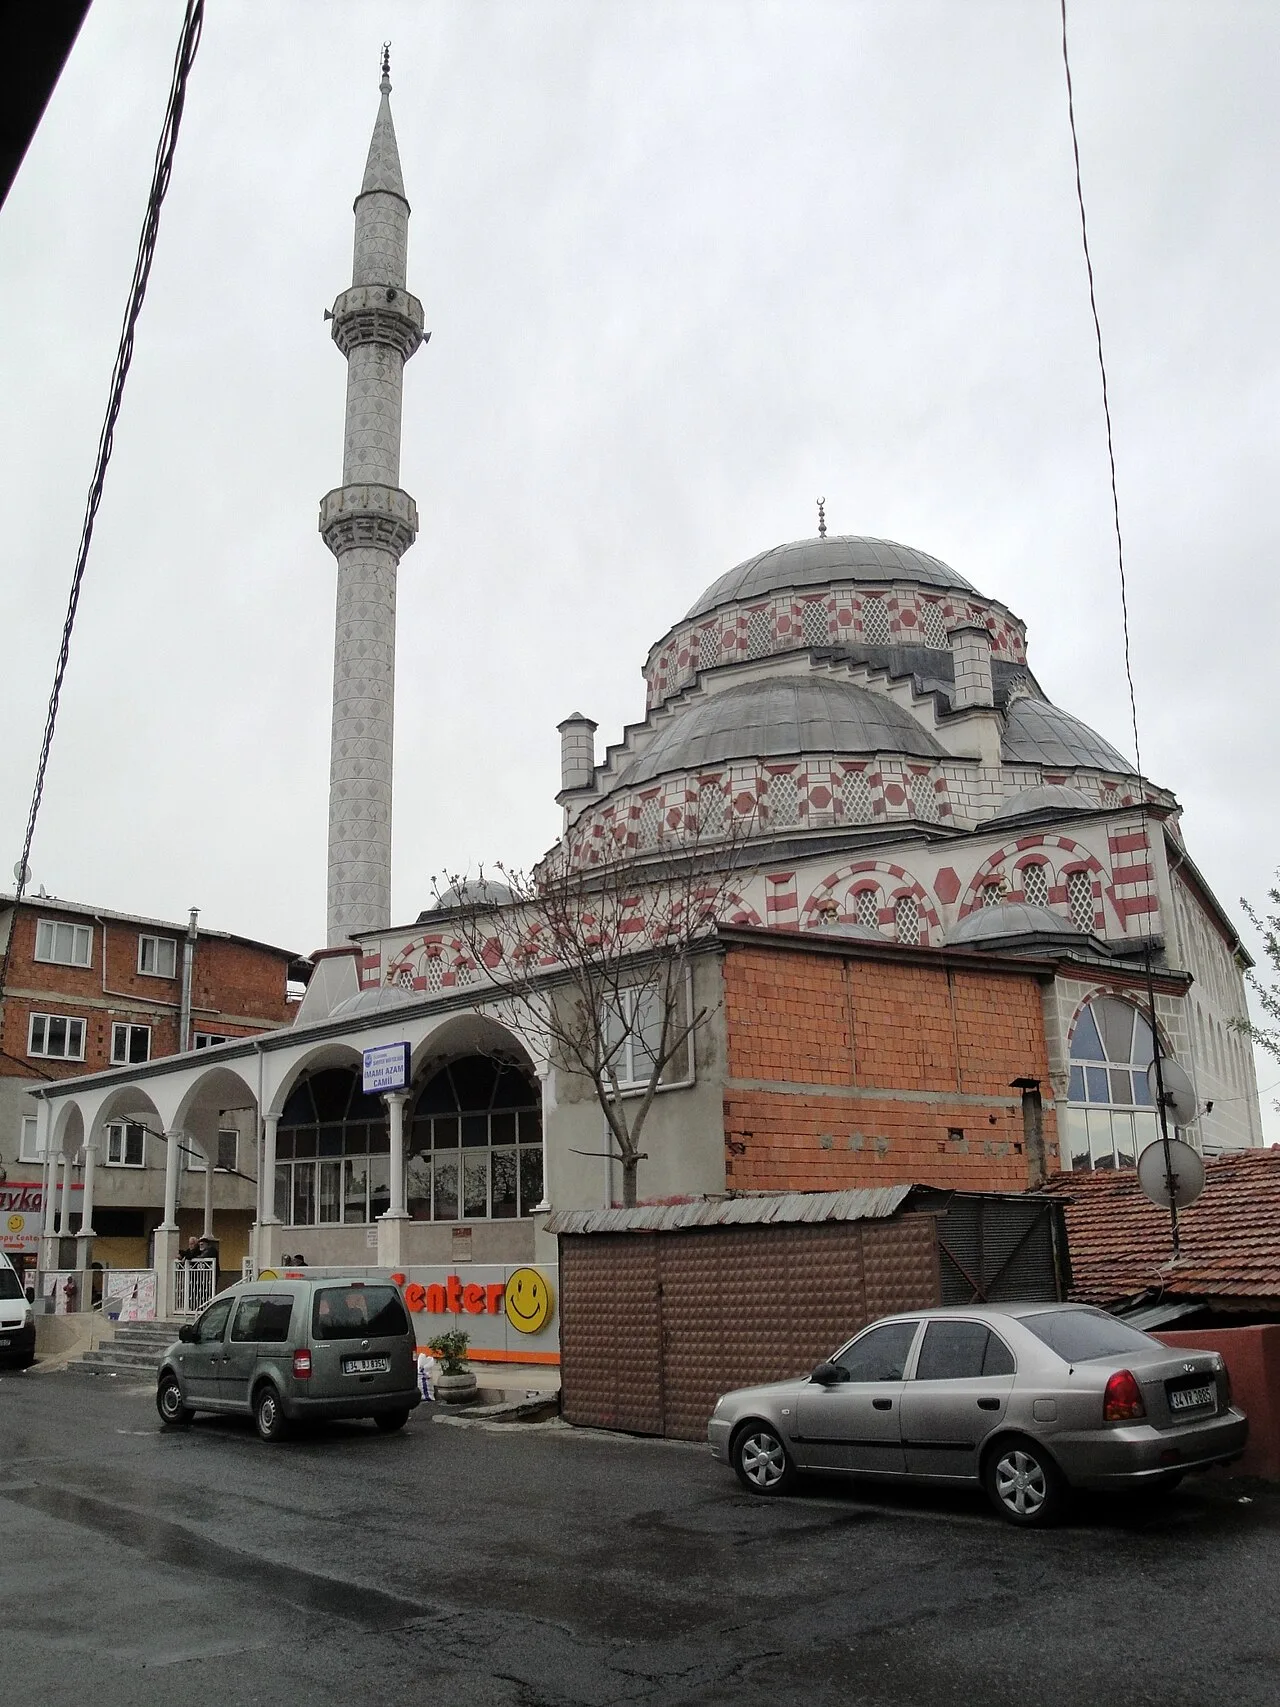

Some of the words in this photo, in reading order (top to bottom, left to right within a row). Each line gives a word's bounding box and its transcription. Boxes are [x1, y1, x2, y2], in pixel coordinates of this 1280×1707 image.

[385, 1064, 404, 1075] AZAM
[373, 1075, 393, 1087] CAMİİ
[350, 1361, 358, 1370] 34
[1173, 1393, 1184, 1407] 34
